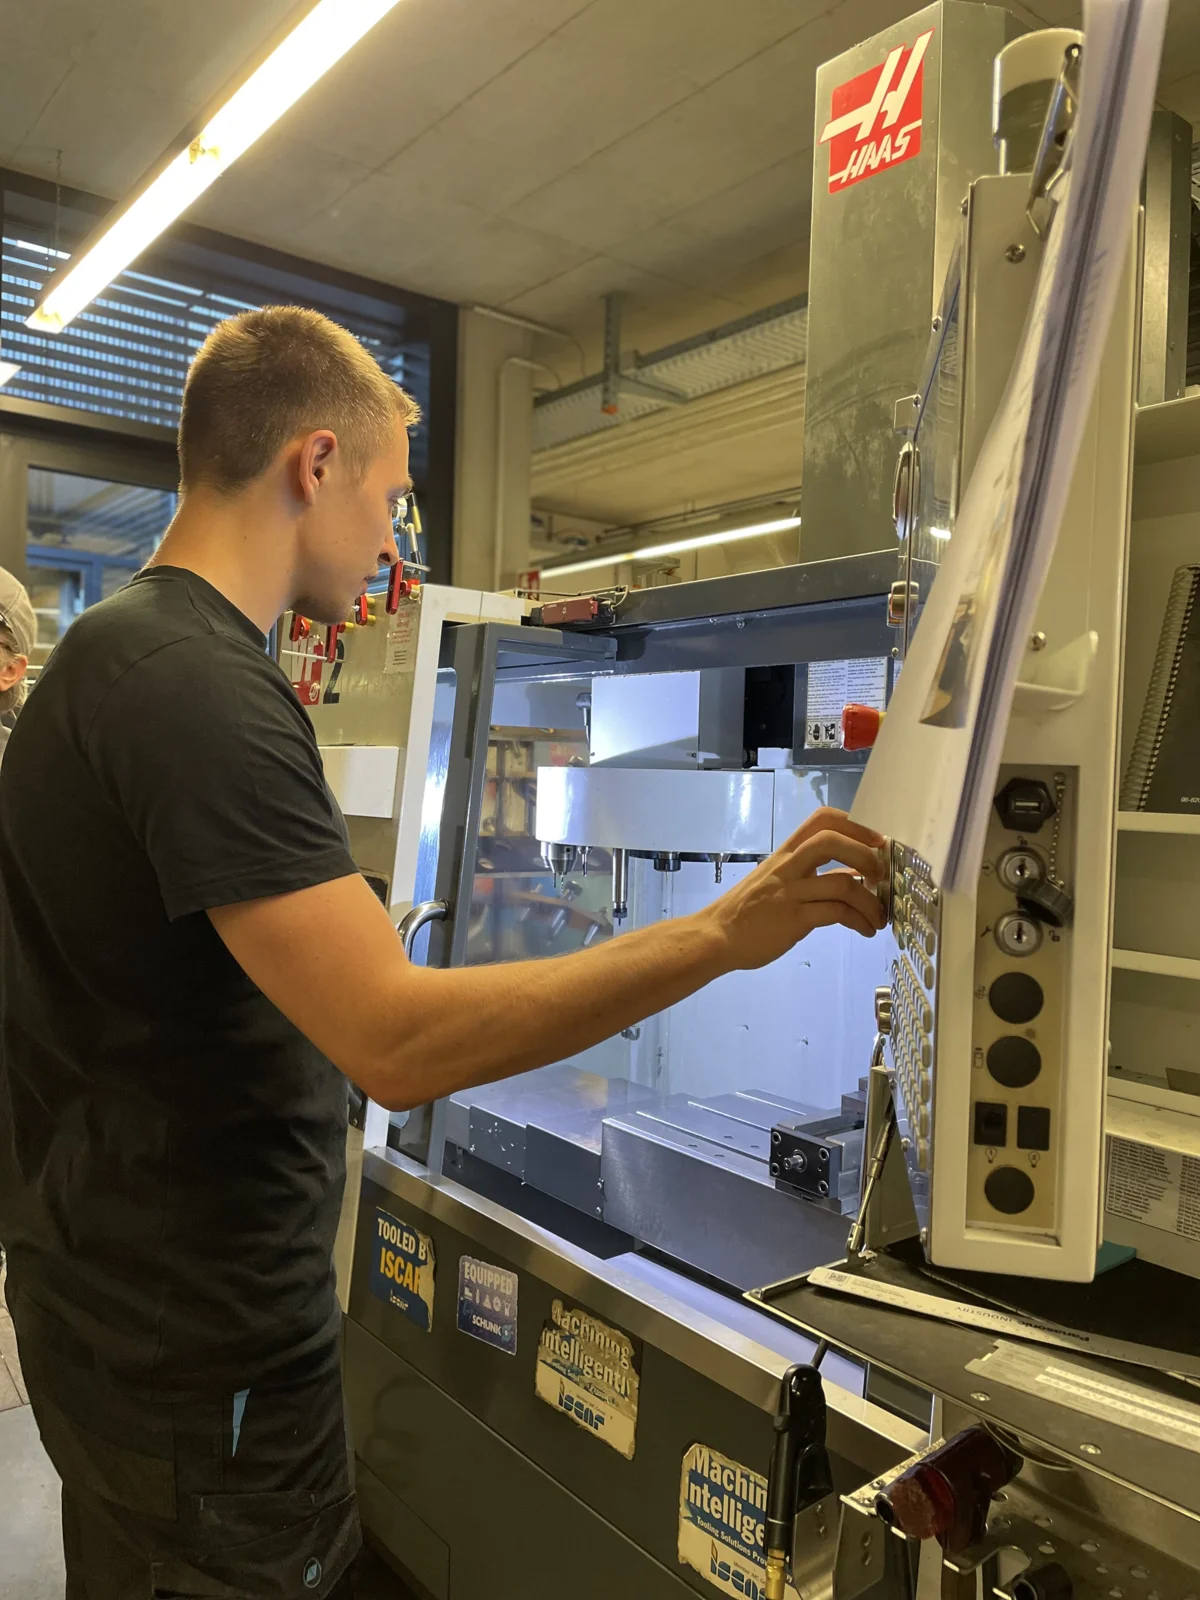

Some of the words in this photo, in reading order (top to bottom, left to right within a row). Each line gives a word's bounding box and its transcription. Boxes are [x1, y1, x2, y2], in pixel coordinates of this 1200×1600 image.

[829, 119, 922, 184] HAAS
[377, 1217, 416, 1255] TOOLED
[418, 1240, 428, 1261] B
[464, 1261, 513, 1296] EQUIPPED
[472, 1314, 502, 1337] SCHUNK
[955, 1305, 1013, 1323] INDUSTRY
[1017, 1319, 1090, 1342] Panasonic
[696, 1515, 720, 1538] Tooling
[720, 1530, 751, 1556] Solutions
